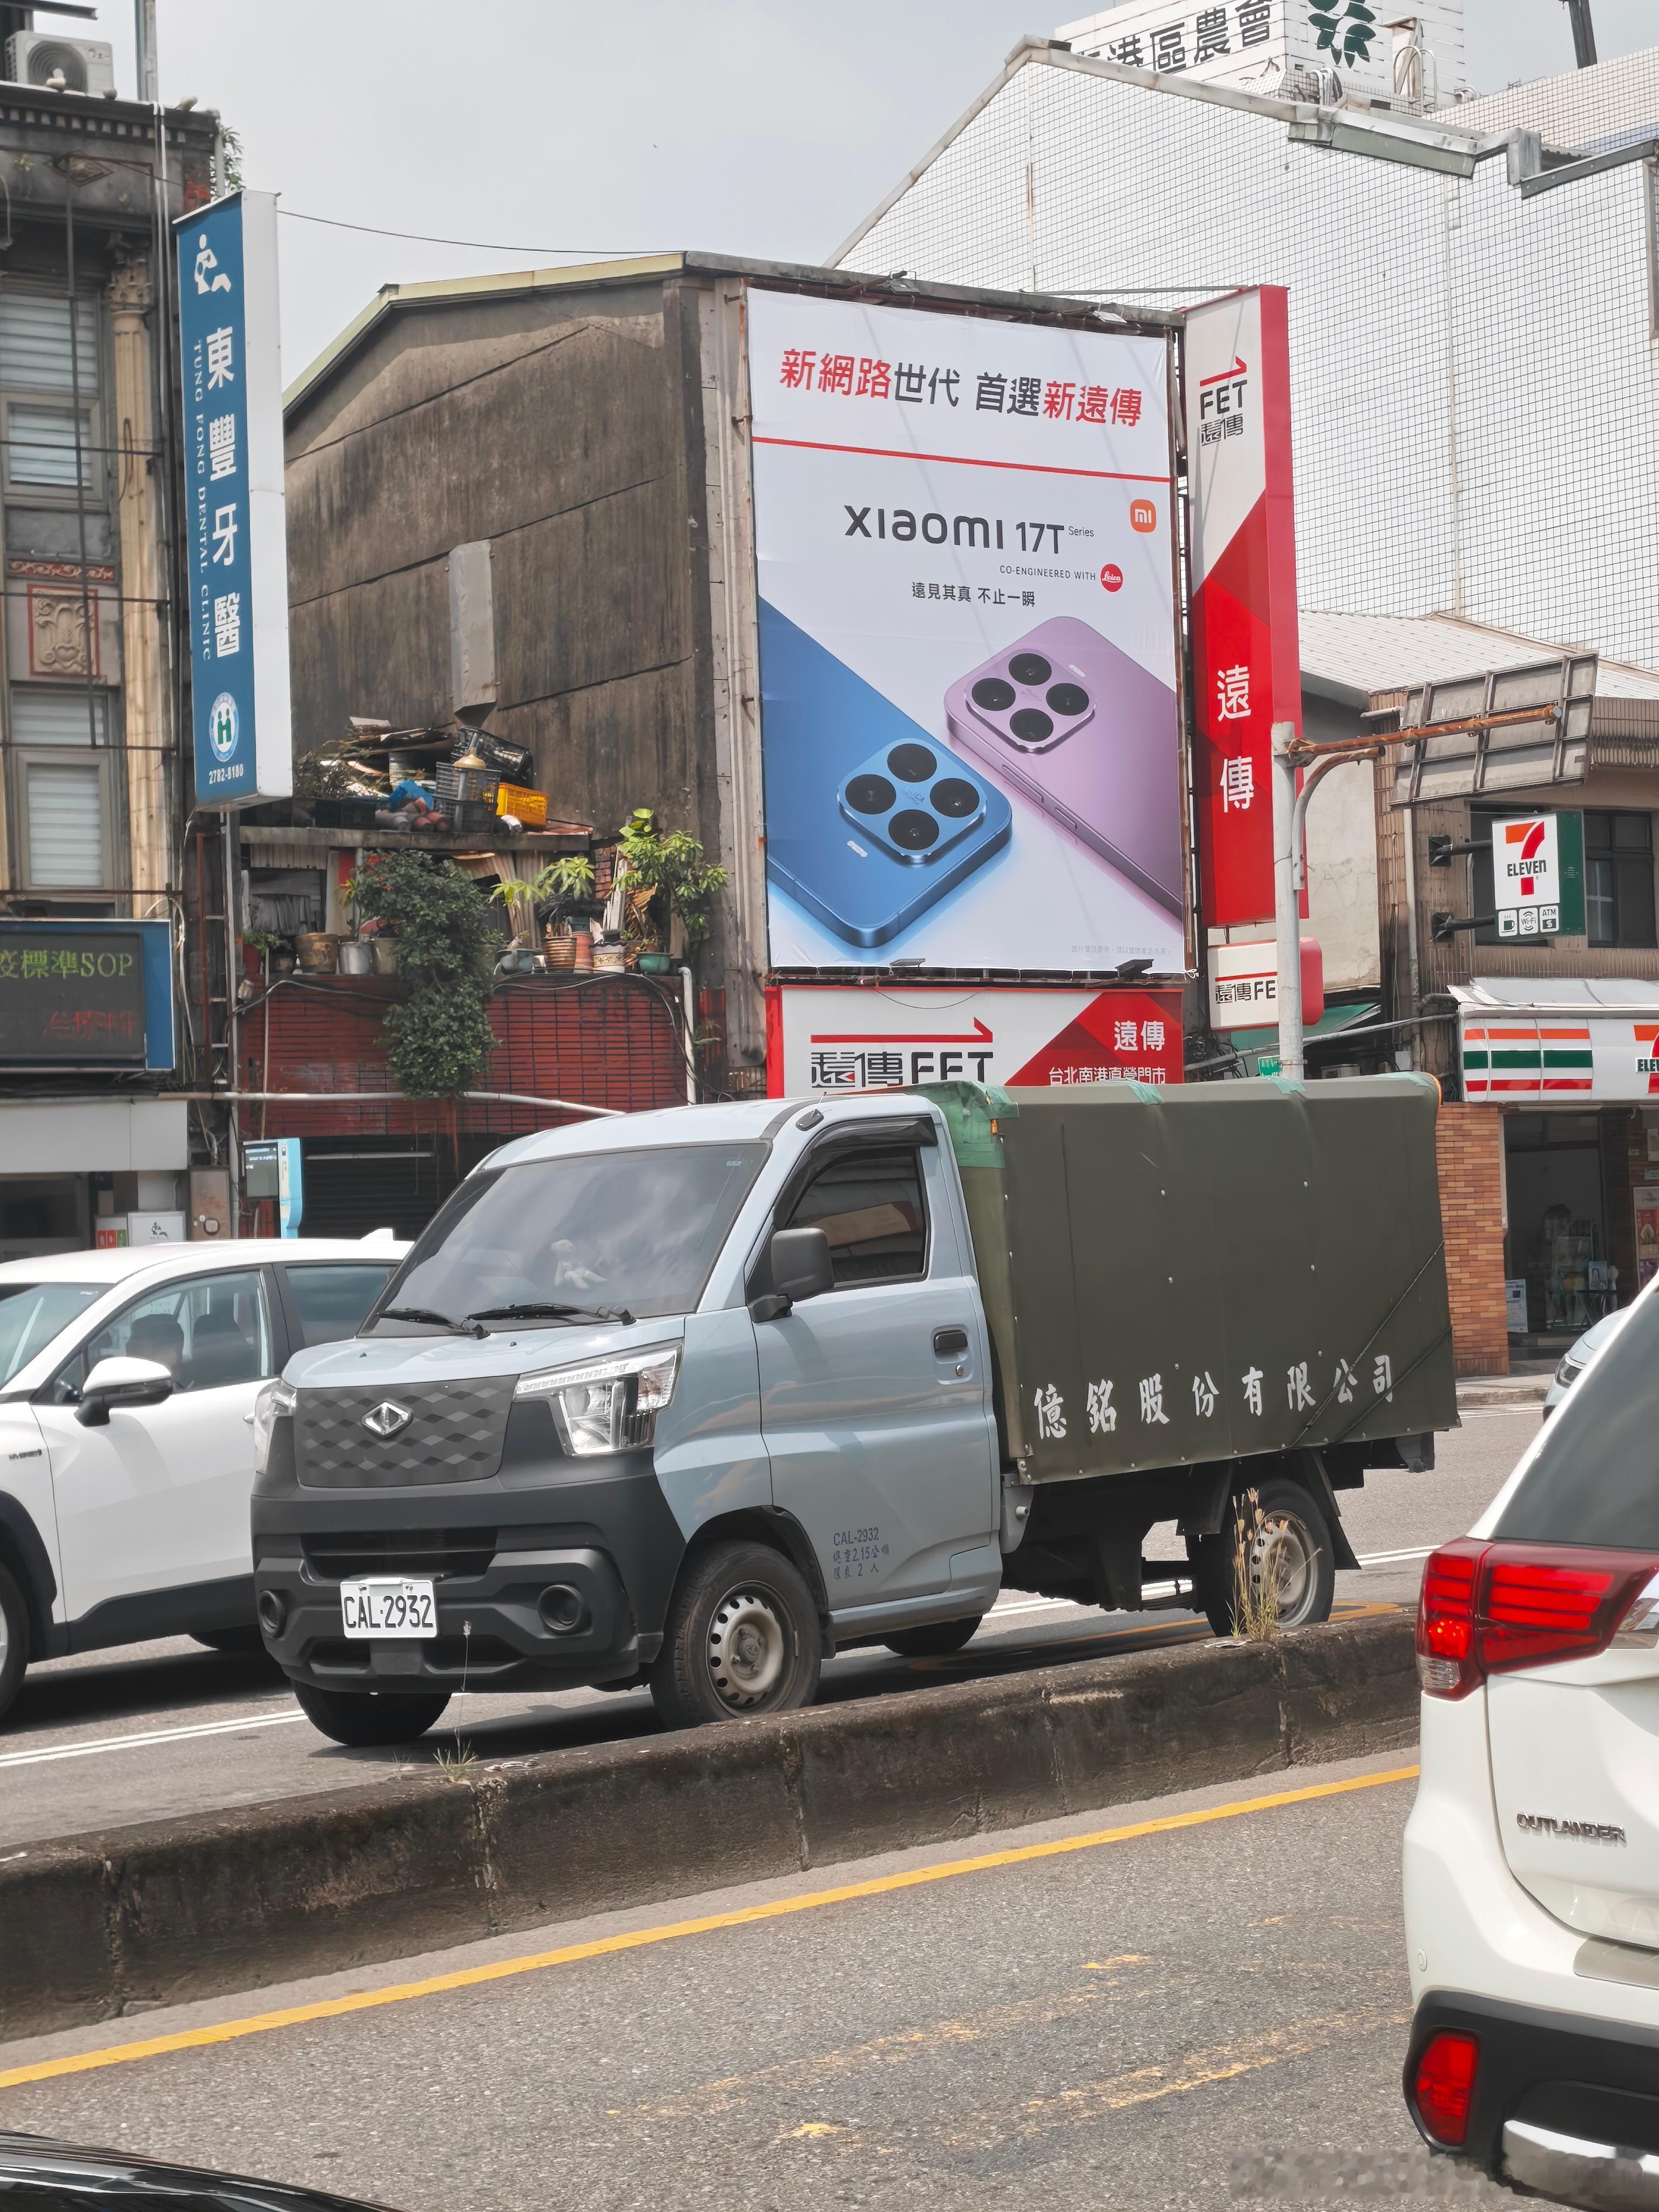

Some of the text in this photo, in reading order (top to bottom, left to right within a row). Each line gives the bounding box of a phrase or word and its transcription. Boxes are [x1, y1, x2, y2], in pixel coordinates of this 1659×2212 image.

[1081, 0, 1271, 74] 港區農會
[779, 348, 1142, 427] 新網路世代 首選新遠傳
[1200, 379, 1247, 420] FET
[1201, 413, 1243, 447] 遠傳
[193, 339, 211, 662] TUNG FONG DENTAL CLINIC
[206, 326, 240, 658] 東豐牙醫
[1016, 522, 1064, 554] 17T
[1068, 526, 1094, 537] Series
[1000, 565, 1070, 579] CO-ENGINEERED
[1074, 571, 1096, 581] WITH
[912, 582, 1036, 607] 遠見其真 不止一瞬
[1217, 664, 1254, 813] 遠傳
[1521, 917, 1536, 925] Wi-Fi
[1542, 908, 1556, 916] ATM
[1215, 980, 1276, 1004] 遠傳 FE
[1114, 1020, 1165, 1051] 遠傳
[811, 1051, 903, 1088] 遠傳
[1049, 1066, 1166, 1085] 台北南港直營門市
[1637, 1058, 1659, 1072] ELE
[344, 1595, 434, 1629] CAL-2932
[1516, 1811, 1627, 1843] OUTLANDER
